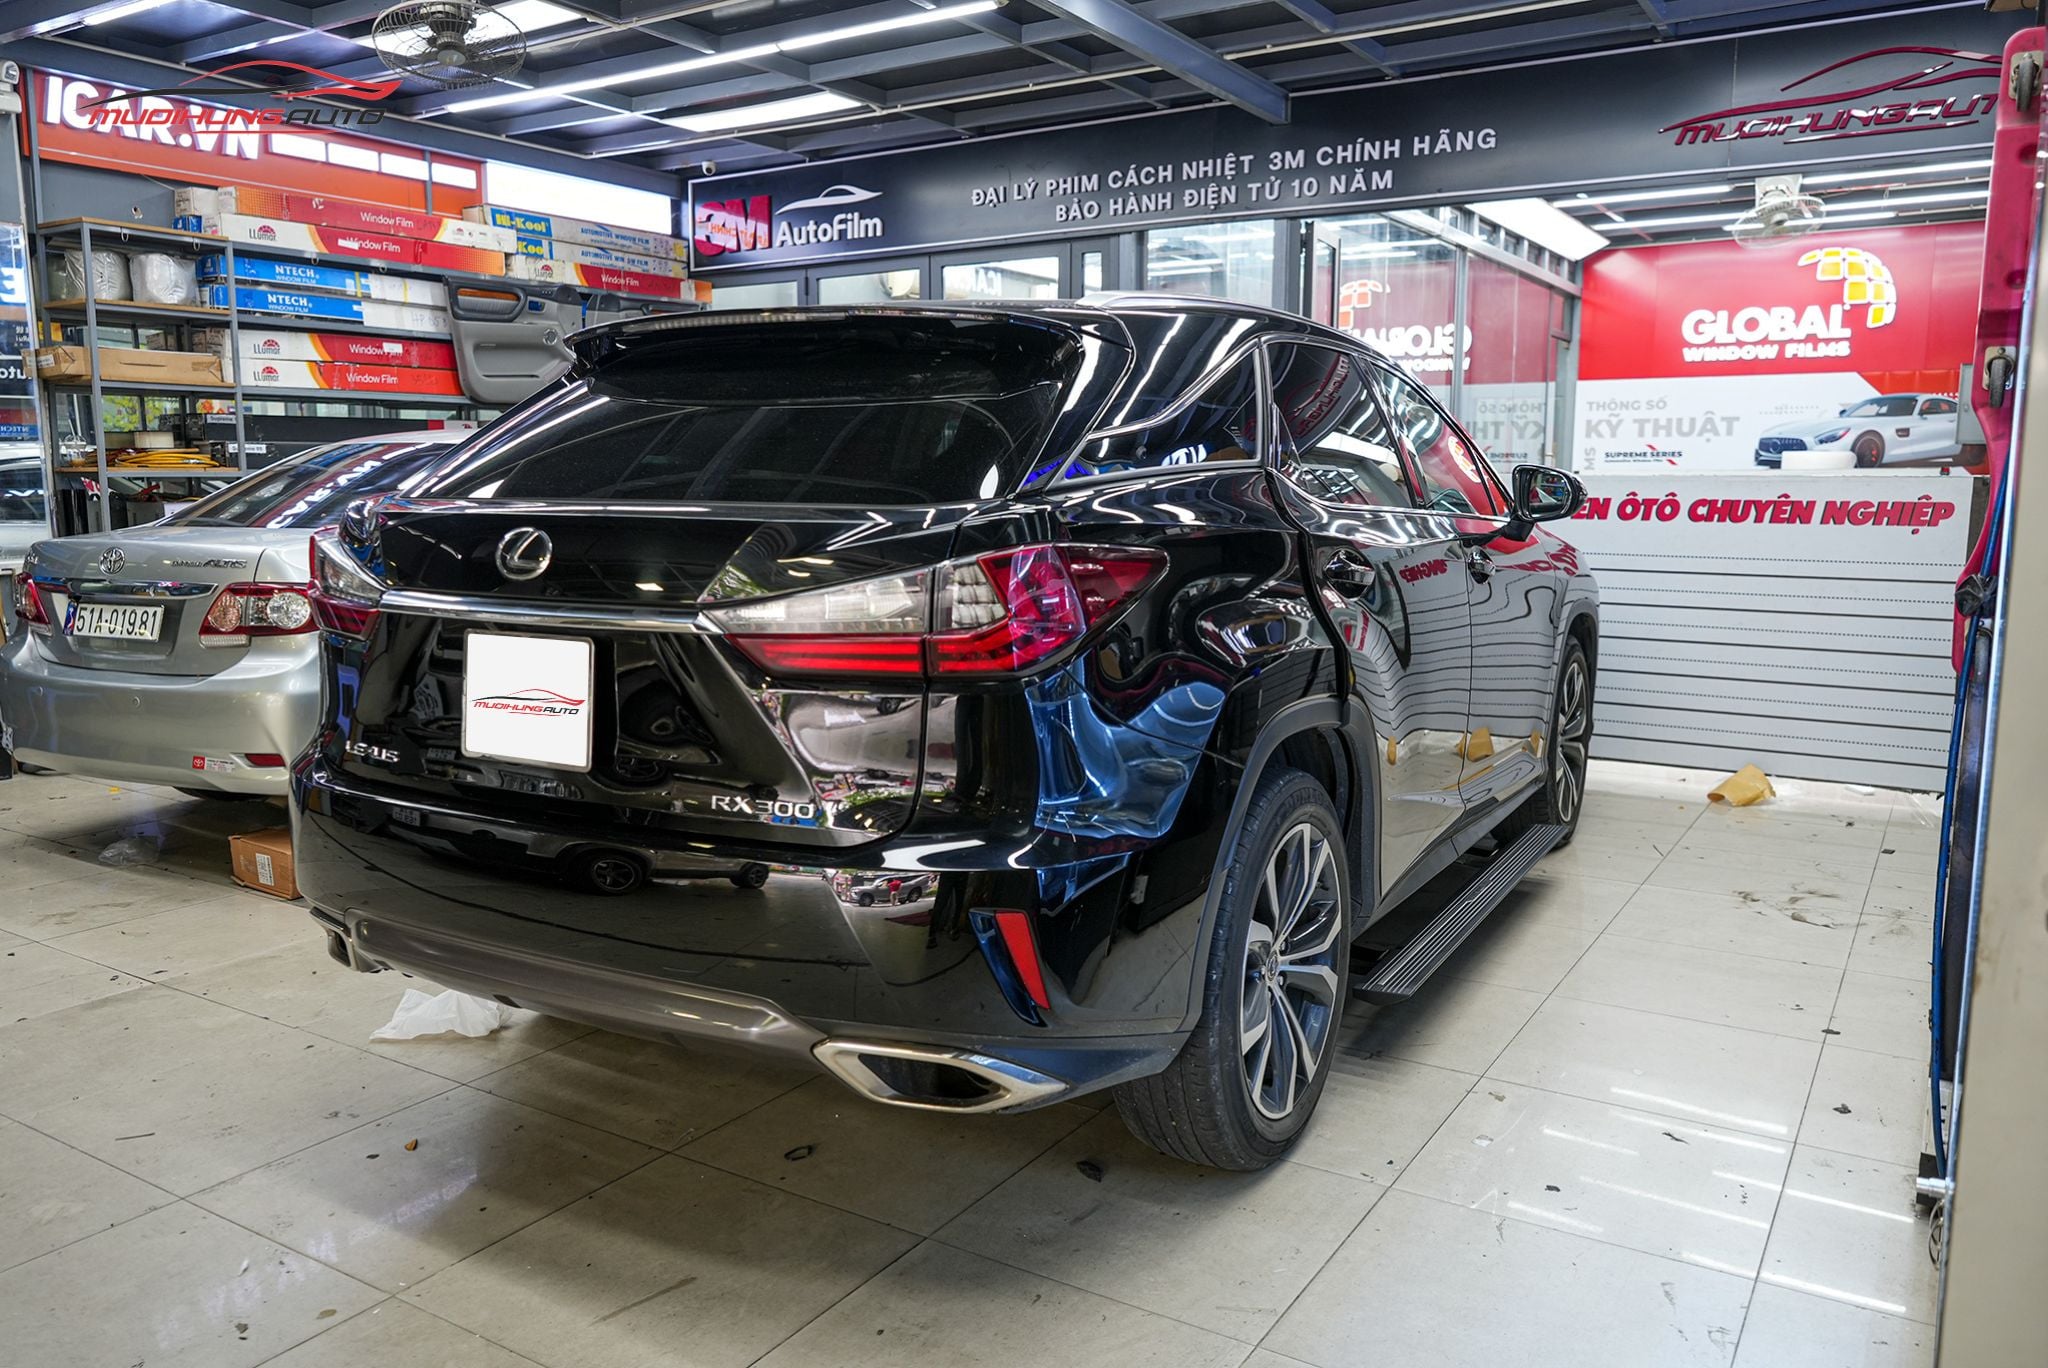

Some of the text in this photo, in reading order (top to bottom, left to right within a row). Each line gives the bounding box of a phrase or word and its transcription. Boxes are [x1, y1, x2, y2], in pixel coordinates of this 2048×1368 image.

[1674, 93, 1999, 146] MUOIHUNGAUT
[971, 128, 1498, 208] ĐẠI LÝ PHIM CÁCH NHIỆT 3M CHÍNH HÃNG
[1056, 168, 1394, 222] BẢO HÀNH ĐIỆN TỬ 10 NĂM
[360, 211, 395, 226] Window
[396, 216, 414, 229] Film
[694, 195, 772, 257] 3M
[776, 212, 884, 248] AutoFilm
[382, 241, 401, 253] Film
[275, 264, 315, 278] NTECH
[267, 293, 308, 307] NTECH
[1681, 303, 1852, 345] GLOBAL
[348, 343, 384, 356] Window
[1682, 341, 1851, 362] WINDOW FILMS
[346, 372, 398, 385] Window Film
[1586, 395, 1668, 413] THÔNG SỐ
[1585, 411, 1741, 443] KỸ THUẬT
[1604, 450, 1683, 459] SUPREME SERIES
[1571, 491, 1955, 535] EN ÔTÔ CHUYÊN NGHIỆP
